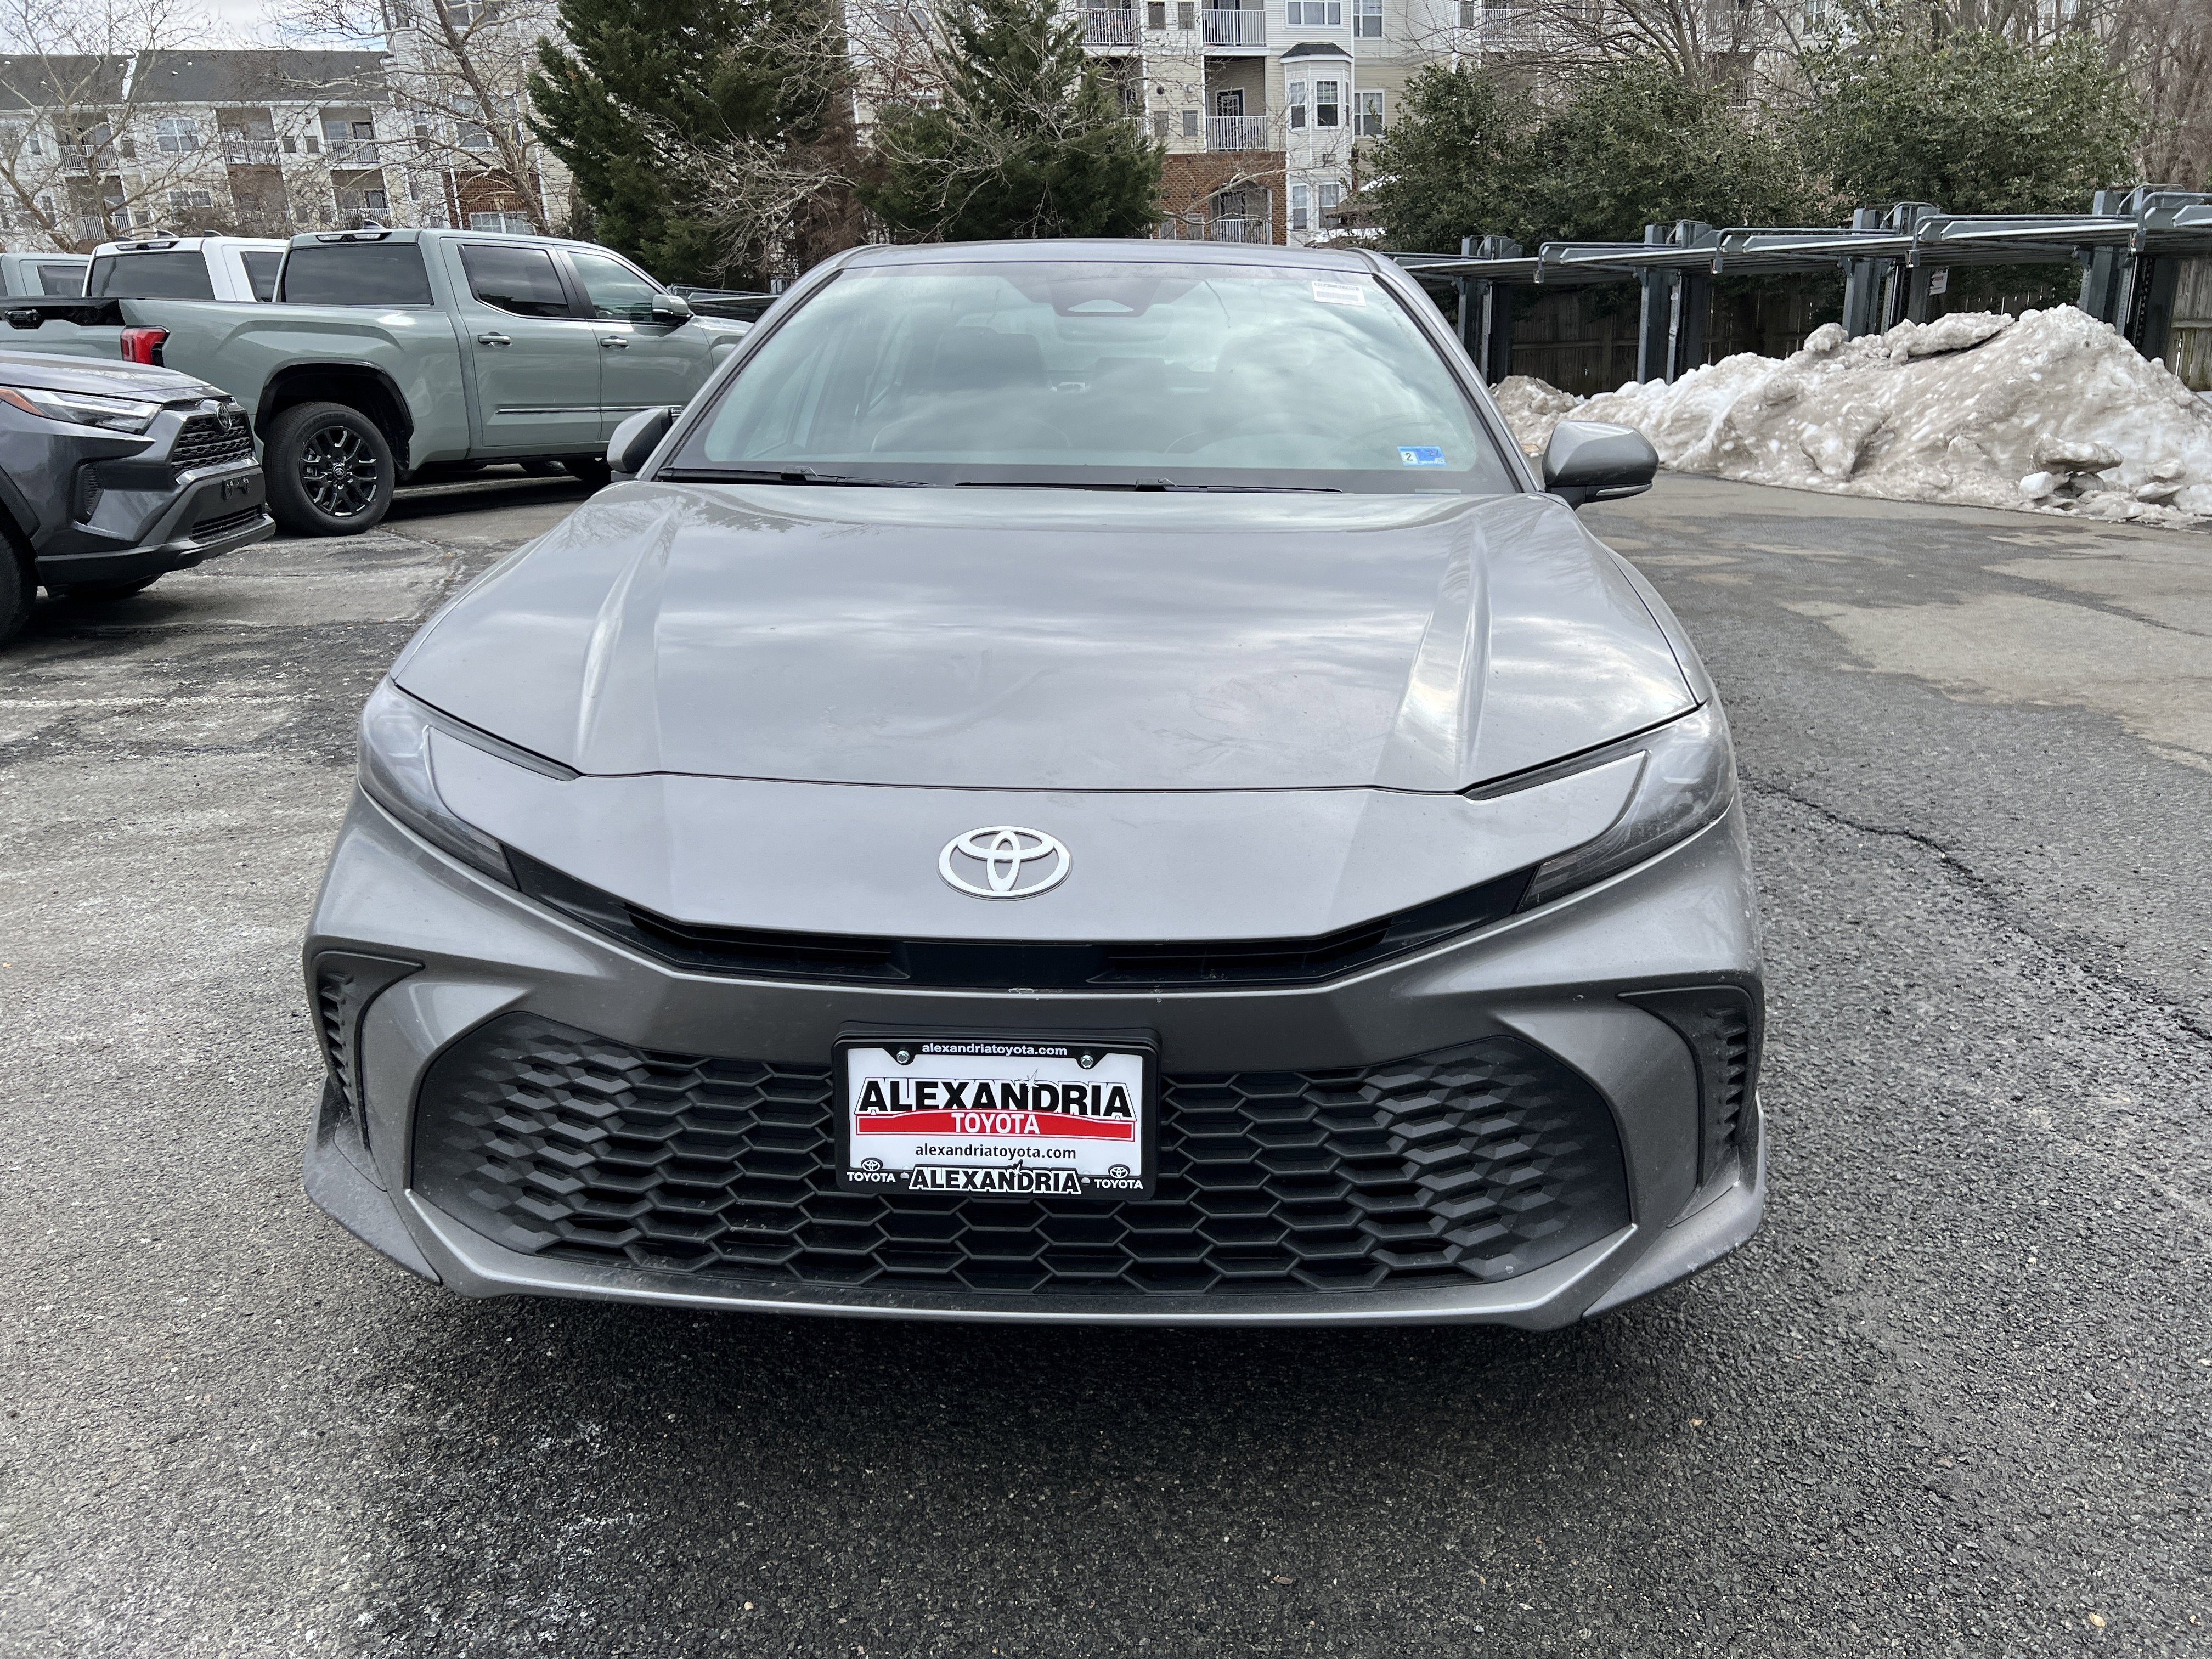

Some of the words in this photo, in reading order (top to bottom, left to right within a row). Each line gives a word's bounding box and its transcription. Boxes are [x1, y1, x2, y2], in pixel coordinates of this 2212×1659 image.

[1405, 453, 1413, 461] 2
[922, 1043, 1068, 1056] alexandriatoyota.com
[858, 1080, 1133, 1118] ALEXANDRIA
[951, 1113, 1040, 1135] TOYOTA
[915, 1143, 1076, 1160] alexandriatoyota.com
[847, 1172, 896, 1183] TOYOTA
[910, 1167, 1081, 1193] ALEXANDRIA
[1094, 1178, 1143, 1189] TOYOTA
